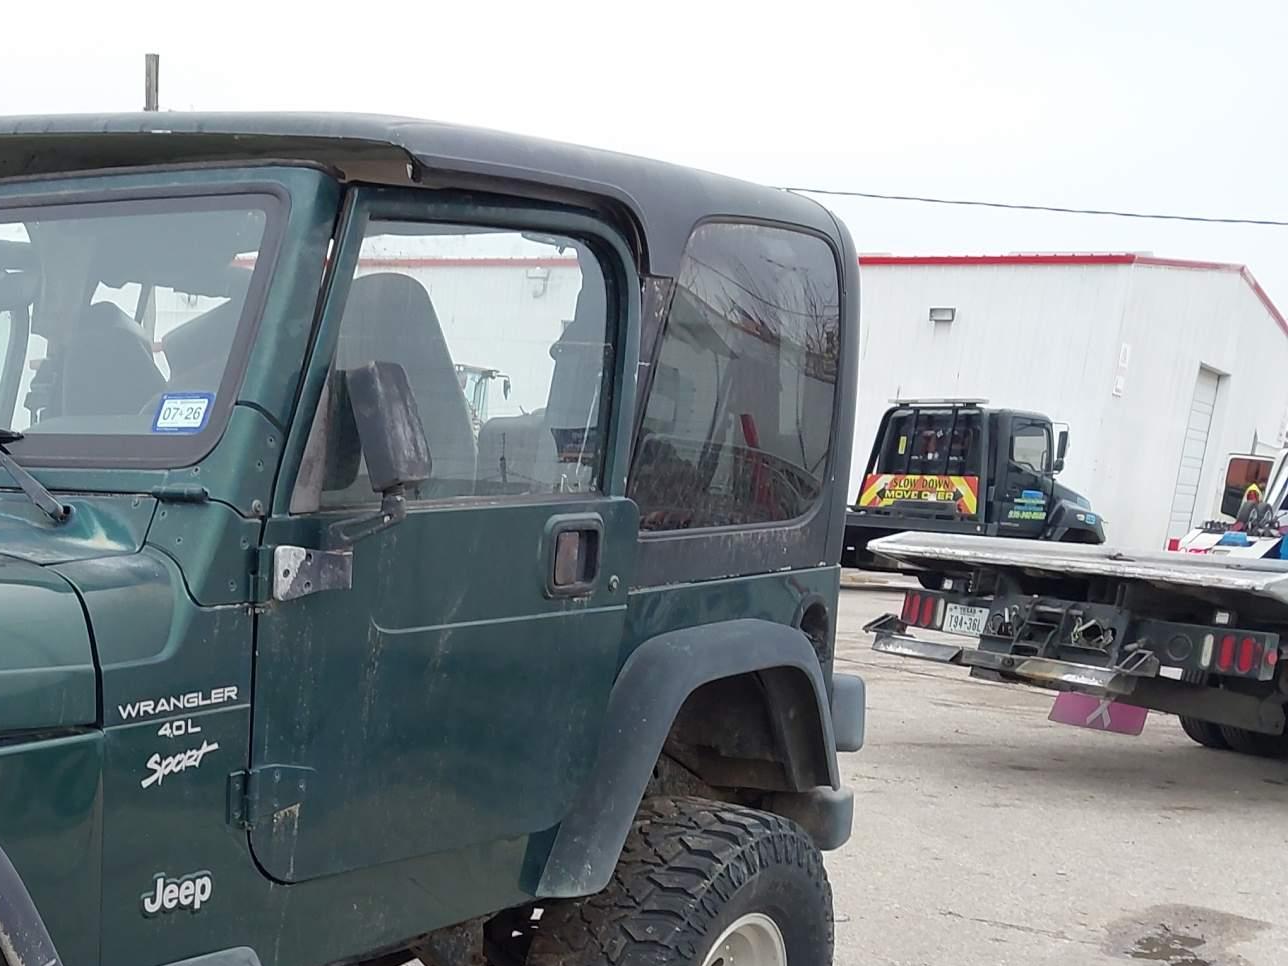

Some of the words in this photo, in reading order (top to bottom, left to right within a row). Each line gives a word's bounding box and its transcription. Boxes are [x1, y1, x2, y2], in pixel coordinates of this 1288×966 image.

[884, 489, 919, 500] MOVE
[921, 490, 955, 501] OER
[892, 479, 918, 490] SLOW
[921, 479, 950, 489] DOWN
[118, 686, 238, 720] WRANGLER
[143, 876, 212, 913] Jeep
